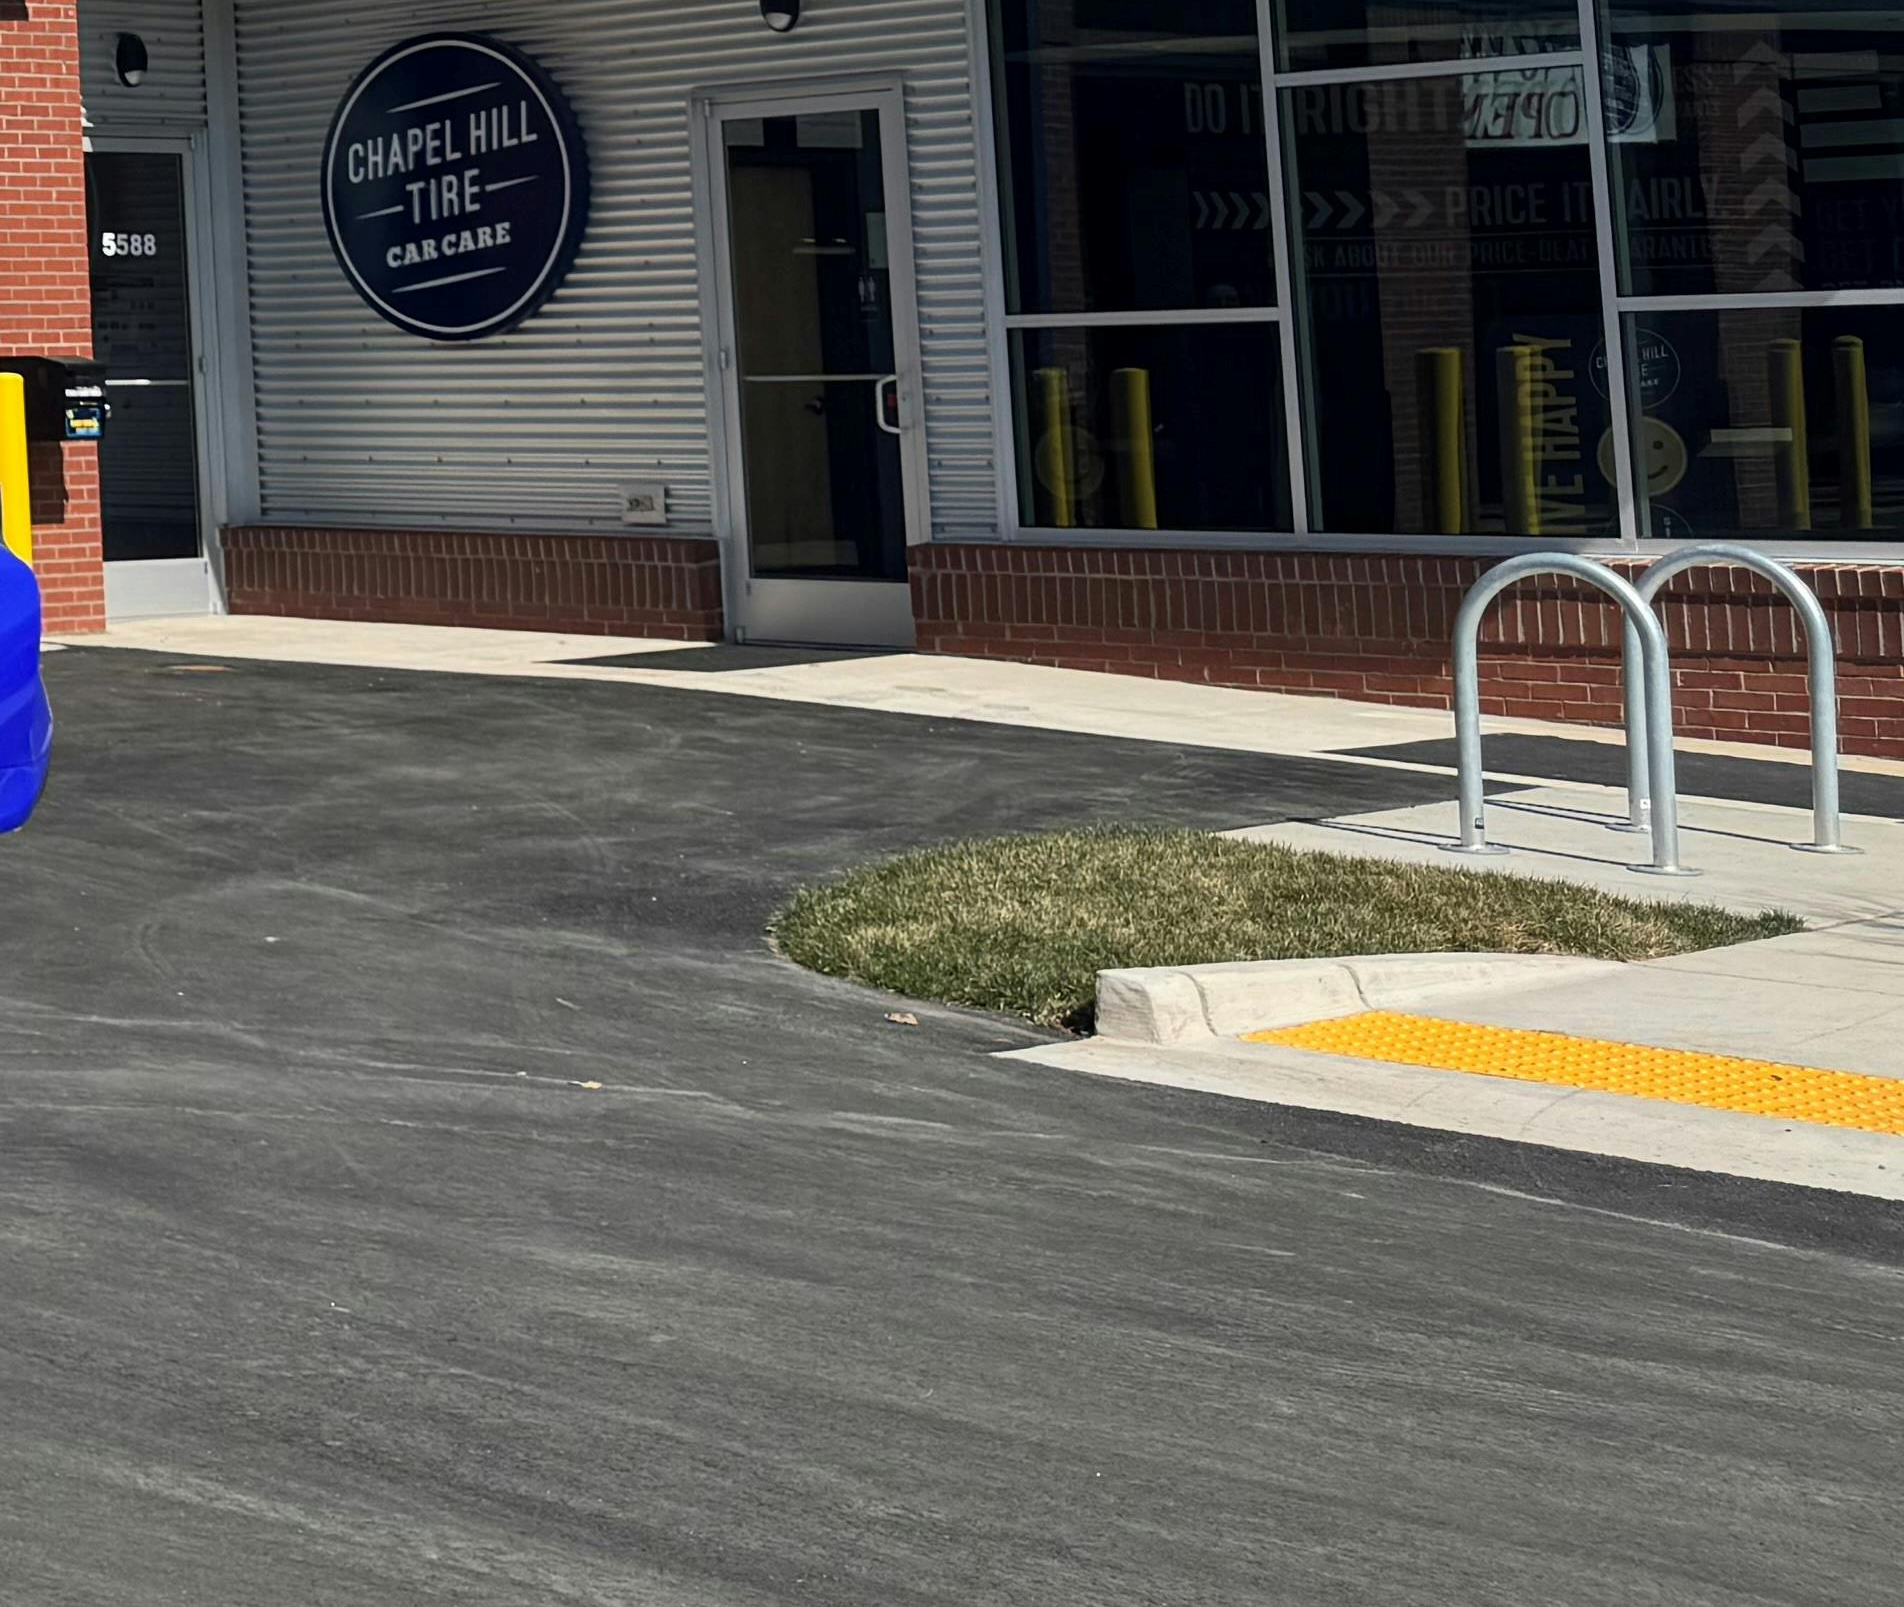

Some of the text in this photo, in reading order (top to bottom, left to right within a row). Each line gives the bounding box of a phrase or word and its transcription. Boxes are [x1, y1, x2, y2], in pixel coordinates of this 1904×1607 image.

[348, 100, 538, 184] CHAPEL HILL
[405, 168, 481, 224] TIRE
[1445, 183, 1546, 226] PRICE
[102, 232, 157, 256] 5588
[386, 221, 511, 268] CAR CARE
[1512, 333, 1581, 460] HAPPY
